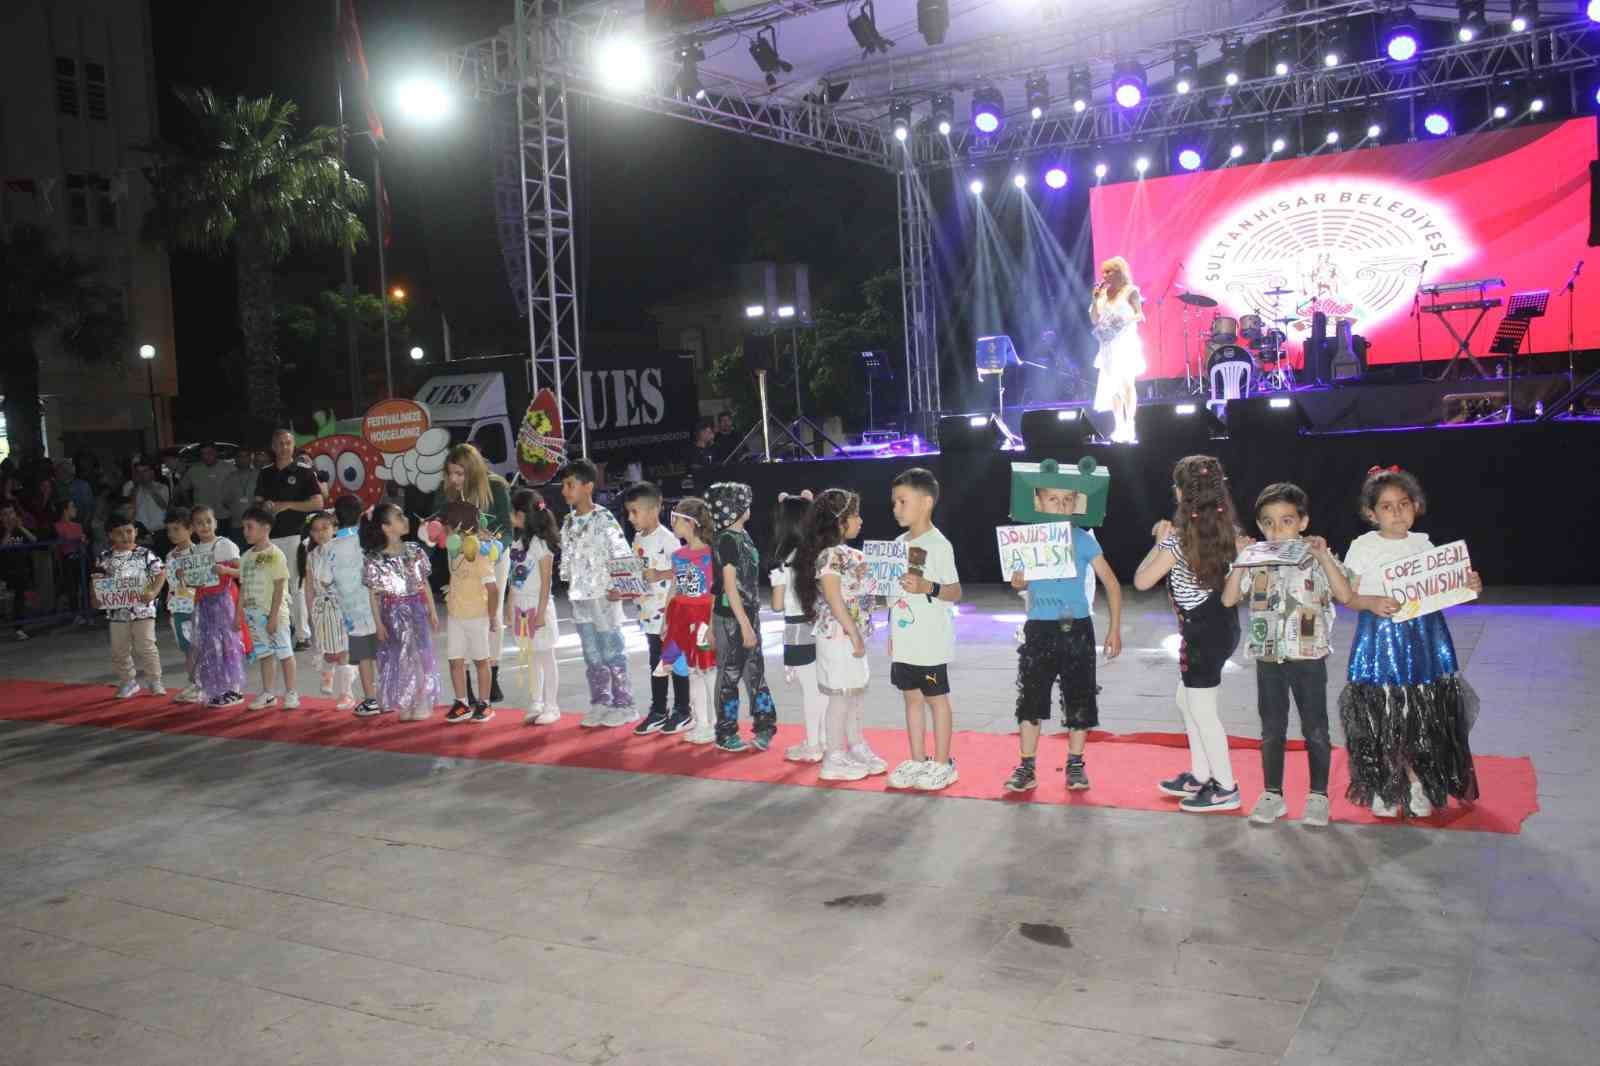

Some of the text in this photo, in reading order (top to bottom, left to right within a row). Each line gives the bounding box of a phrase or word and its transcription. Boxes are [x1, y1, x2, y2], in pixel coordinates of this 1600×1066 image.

[1339, 192, 1454, 258] BELEDİYESİ
[426, 383, 479, 406] UES
[582, 368, 665, 430] UES
